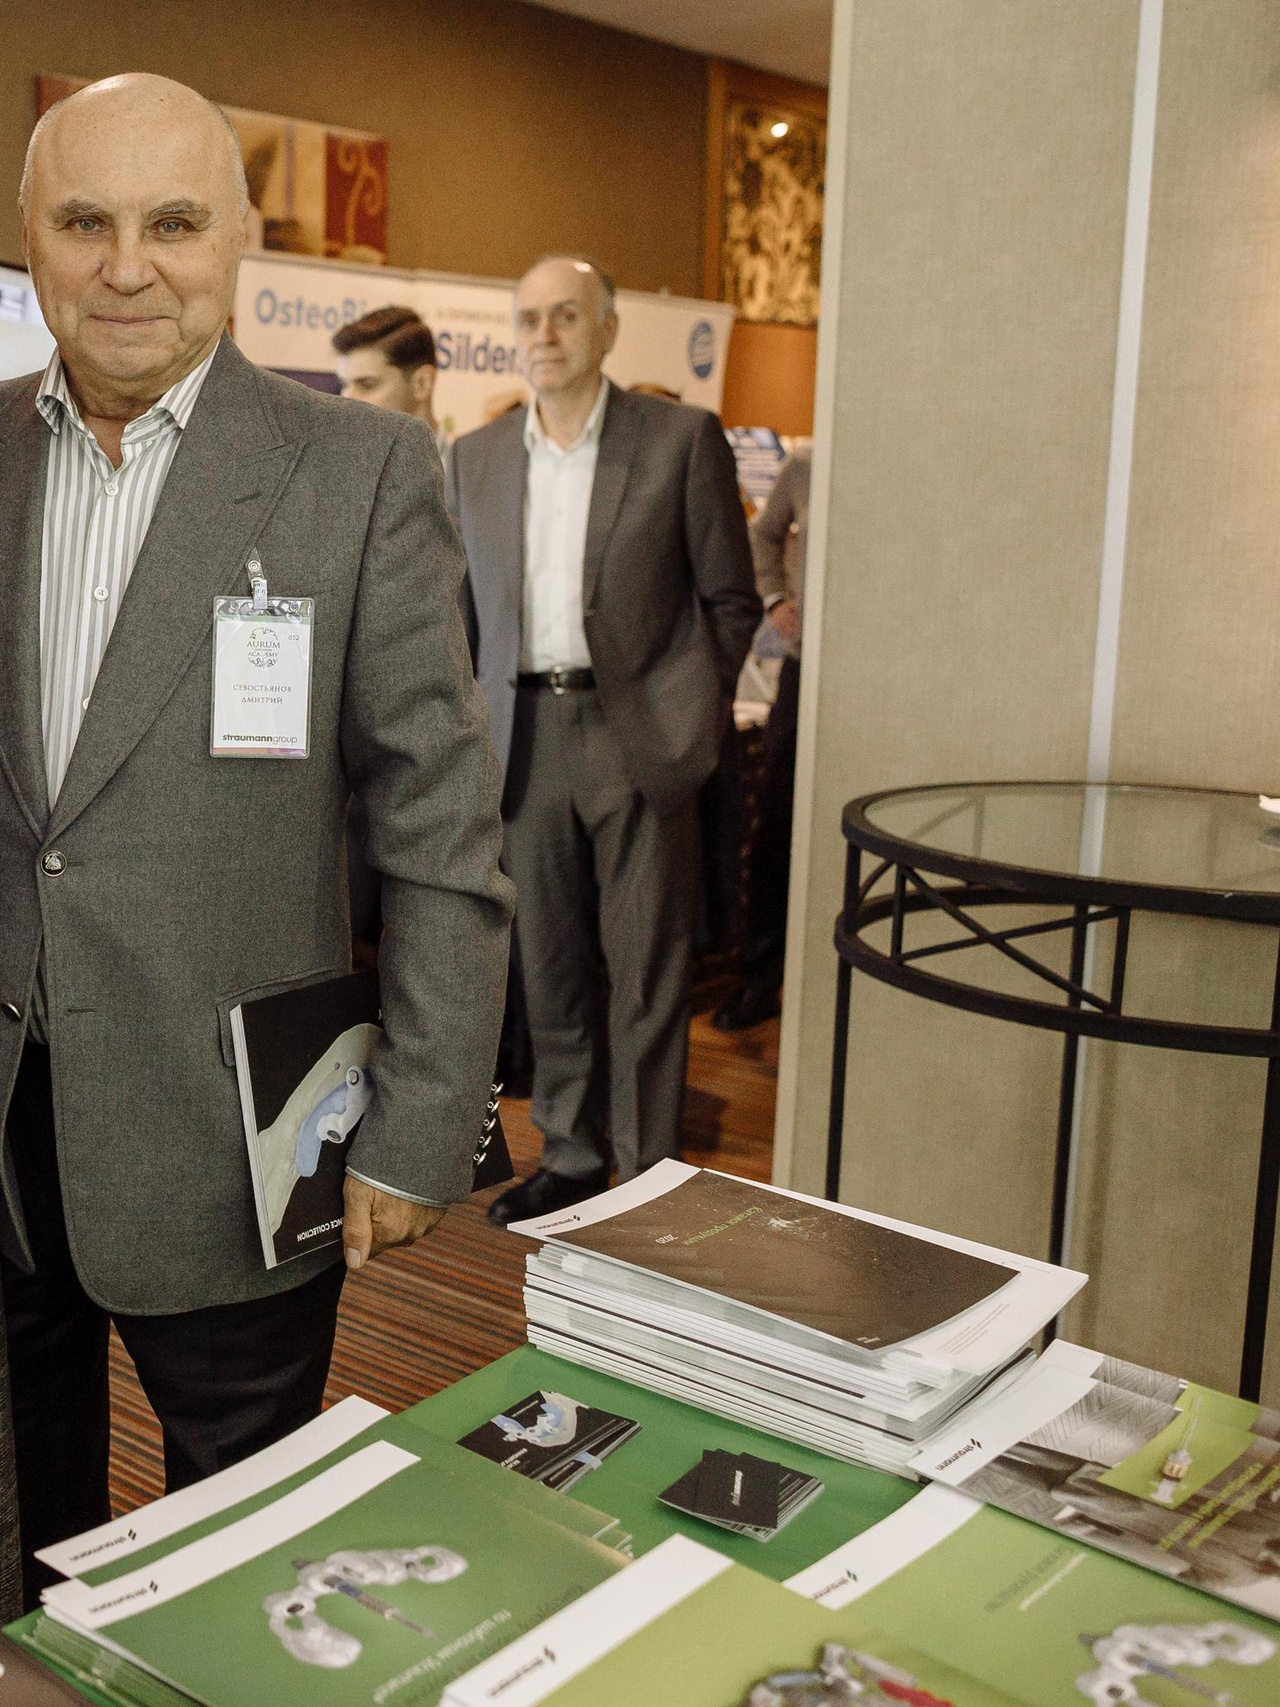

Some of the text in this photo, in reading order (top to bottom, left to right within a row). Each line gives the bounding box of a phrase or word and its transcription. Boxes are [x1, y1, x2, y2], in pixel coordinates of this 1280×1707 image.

[255, 288, 368, 331] OsteoB
[246, 641, 281, 649] AURUM
[233, 684, 292, 693] СЕВОСТЬЯНОВ
[241, 696, 283, 704] ДМИТРИЙ
[222, 733, 298, 745] straumanngroup
[296, 1222, 330, 1242] COLLECTION
